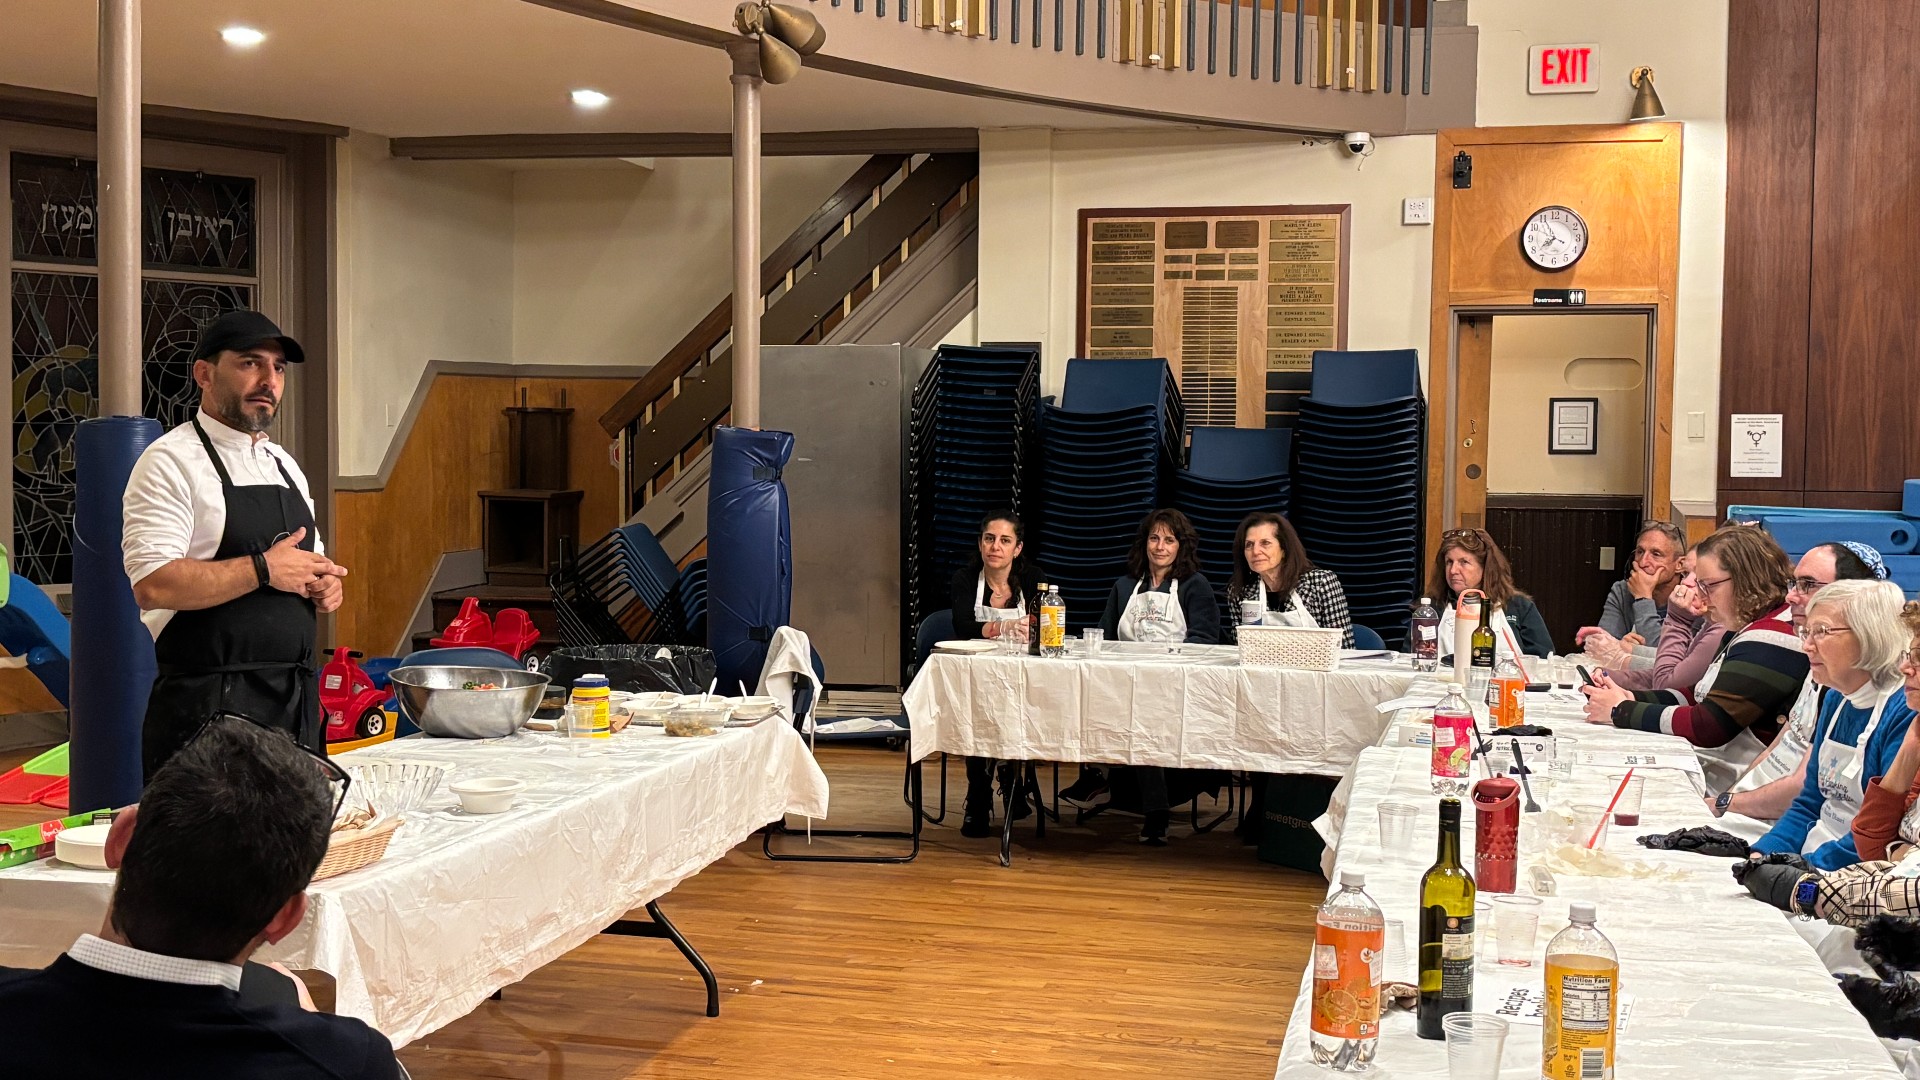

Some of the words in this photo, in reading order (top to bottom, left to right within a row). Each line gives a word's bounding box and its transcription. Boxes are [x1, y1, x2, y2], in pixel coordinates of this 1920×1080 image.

[1542, 48, 1591, 85] EXIT
[41, 200, 98, 235] מעון
[1540, 214, 1547, 223] 11
[1551, 211, 1560, 220] 12
[1565, 214, 1569, 223] 1
[1530, 223, 1539, 232] 10
[1572, 223, 1578, 231] 2
[1527, 234, 1534, 243] 9
[1575, 234, 1581, 242] 3
[1530, 246, 1537, 254] 8
[1572, 246, 1577, 254] 4
[1539, 254, 1545, 262] 7
[1551, 257, 1557, 265] 6
[1563, 254, 1569, 262] 5
[1563, 975, 1593, 984] Nutrition
[1496, 988, 1531, 1016] Recipes
